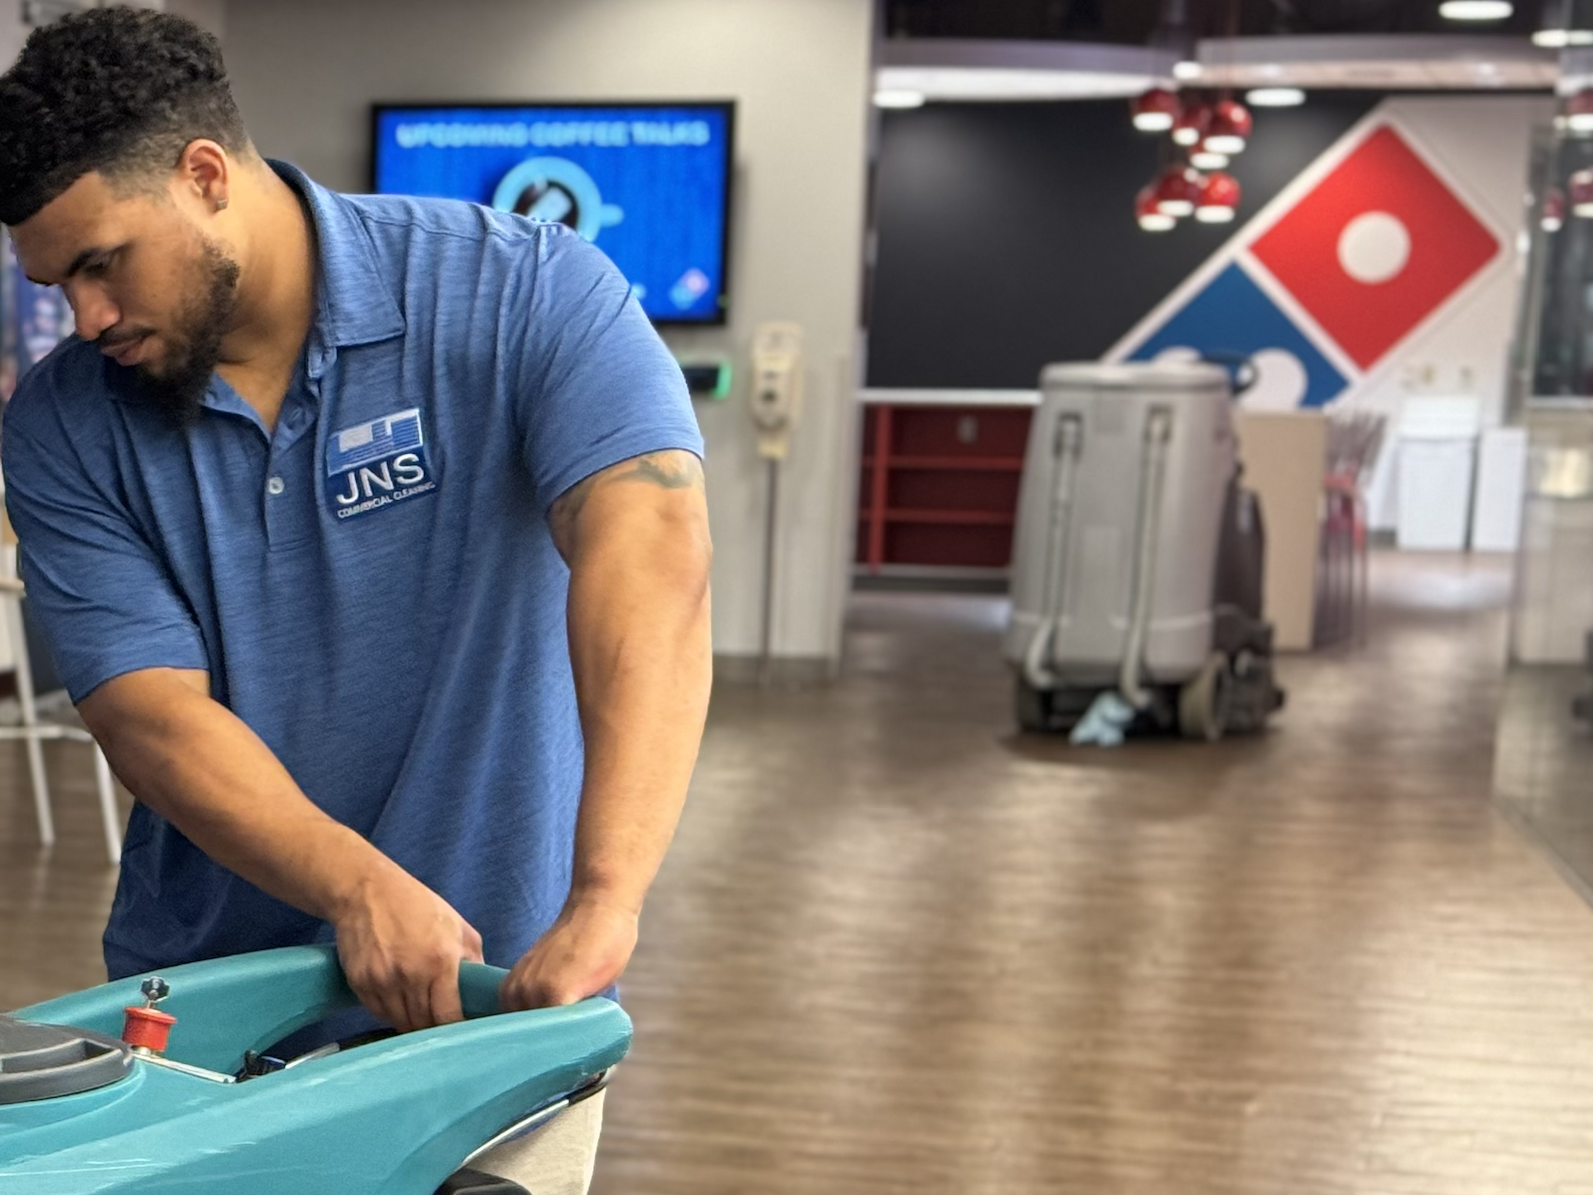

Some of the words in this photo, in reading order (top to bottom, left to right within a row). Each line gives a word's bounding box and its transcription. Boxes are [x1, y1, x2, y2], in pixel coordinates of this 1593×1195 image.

[529, 121, 629, 147] COFFEE
[631, 120, 710, 146] TALKS
[336, 453, 425, 505] JNS
